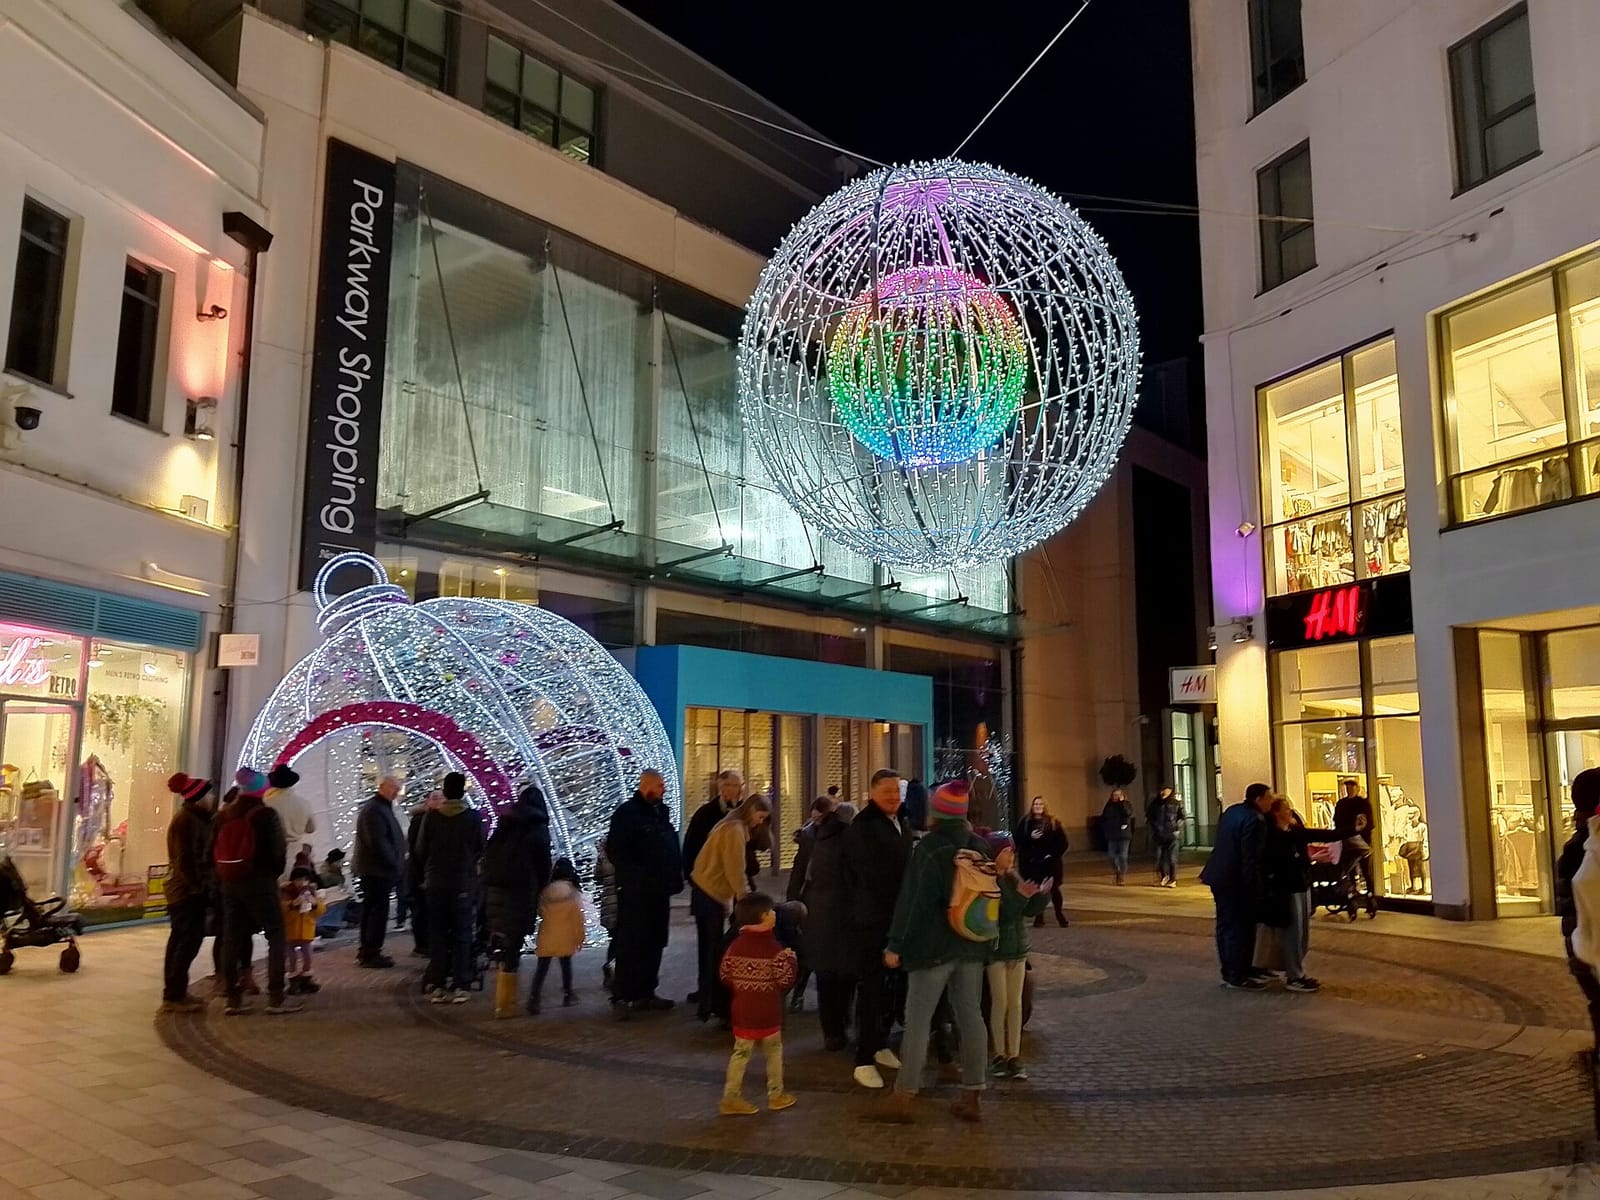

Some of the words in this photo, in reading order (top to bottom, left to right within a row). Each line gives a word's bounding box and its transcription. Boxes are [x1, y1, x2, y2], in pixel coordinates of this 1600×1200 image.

[336, 178, 384, 341] Parkway
[319, 347, 372, 535] Shopping
[1304, 585, 1360, 640] H&M
[49, 675, 77, 697] RETRO
[1181, 674, 1208, 694] H&M
